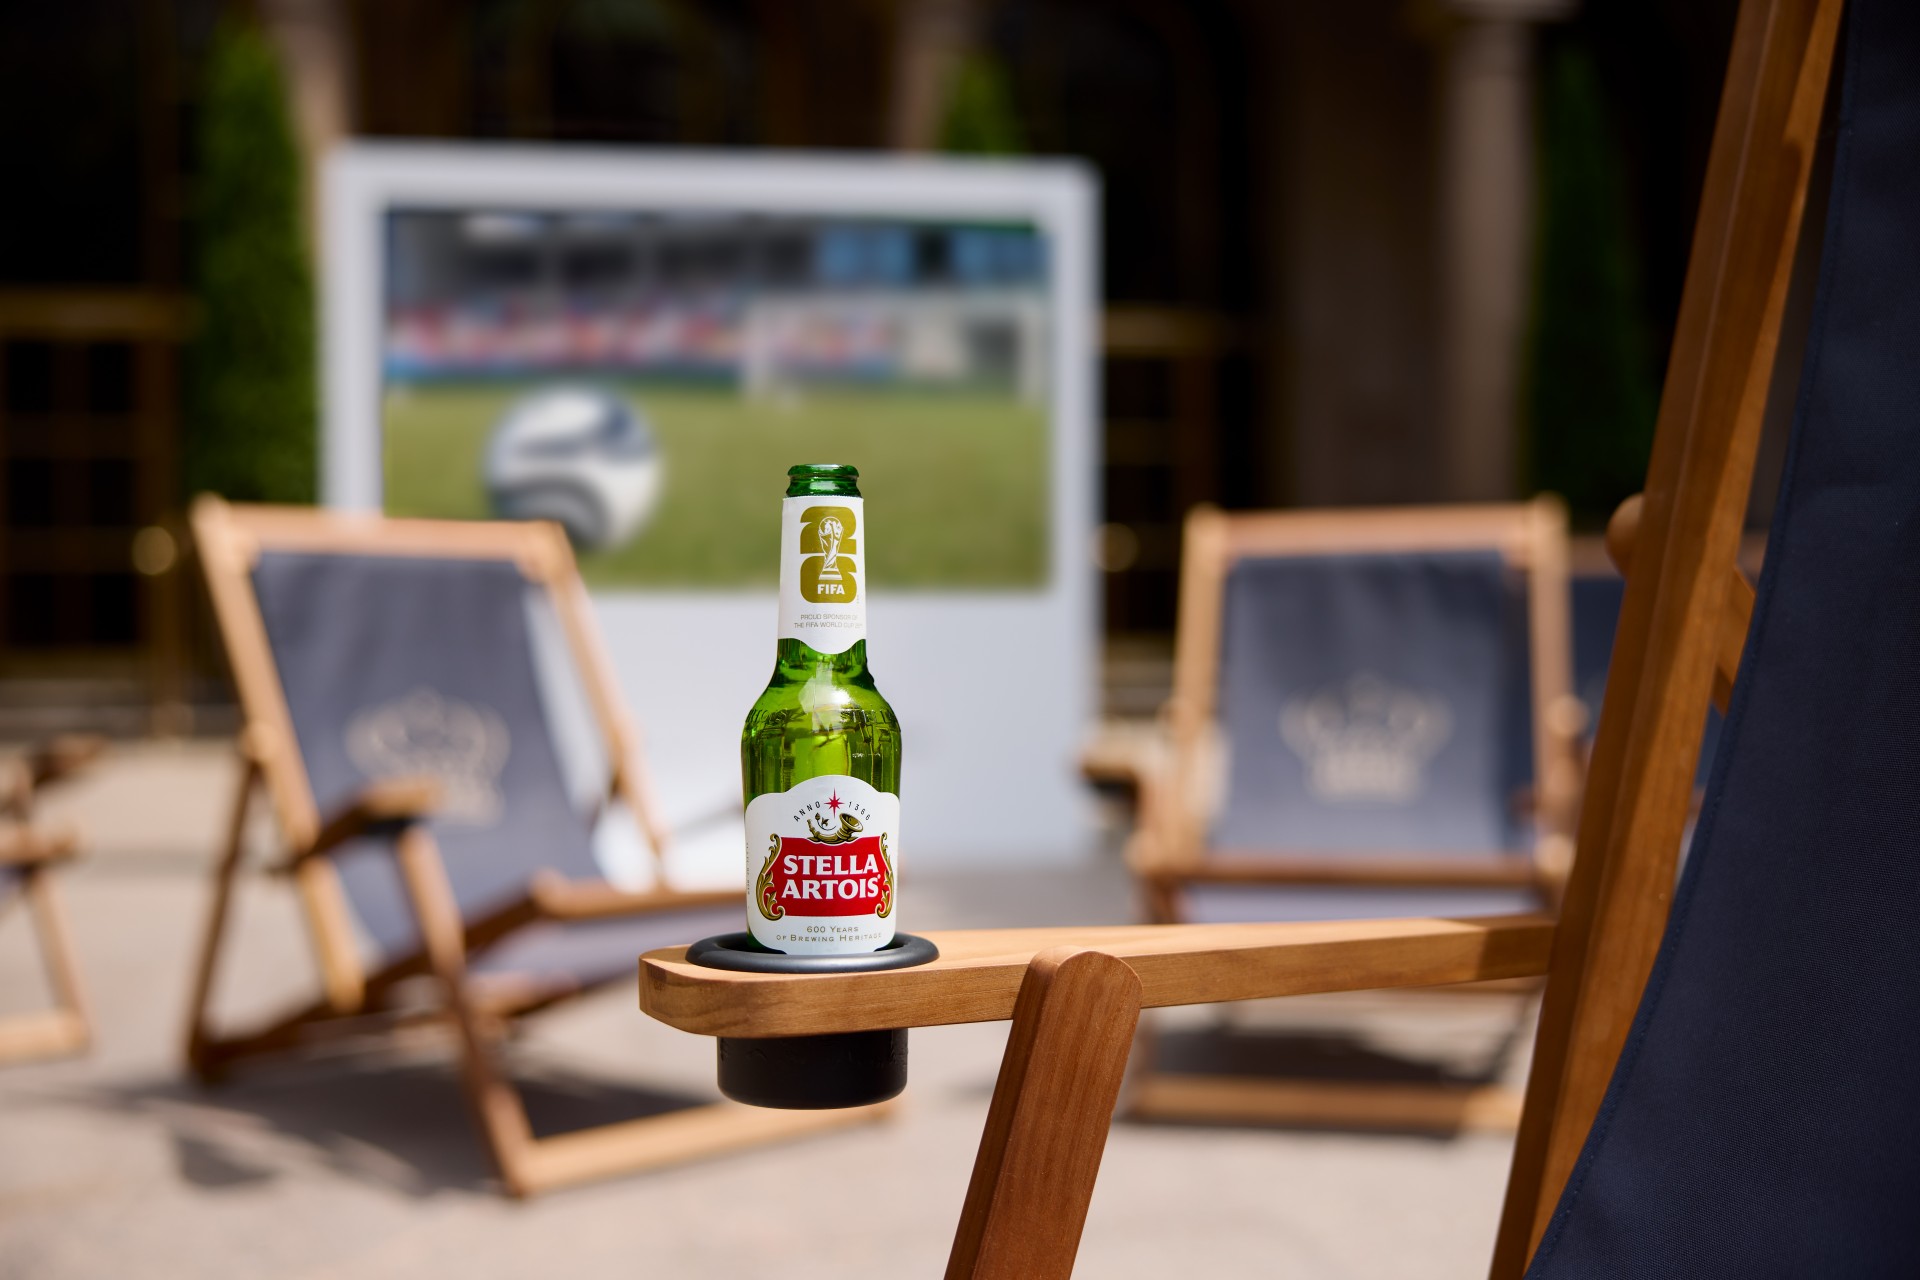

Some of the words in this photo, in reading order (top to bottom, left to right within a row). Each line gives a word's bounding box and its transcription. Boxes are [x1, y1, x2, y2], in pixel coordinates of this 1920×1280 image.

[817, 584, 845, 595] FIFA
[793, 801, 821, 822] ANNO
[848, 801, 871, 821] 1366
[783, 853, 879, 876] STELLA
[781, 877, 880, 900] ARTOIS
